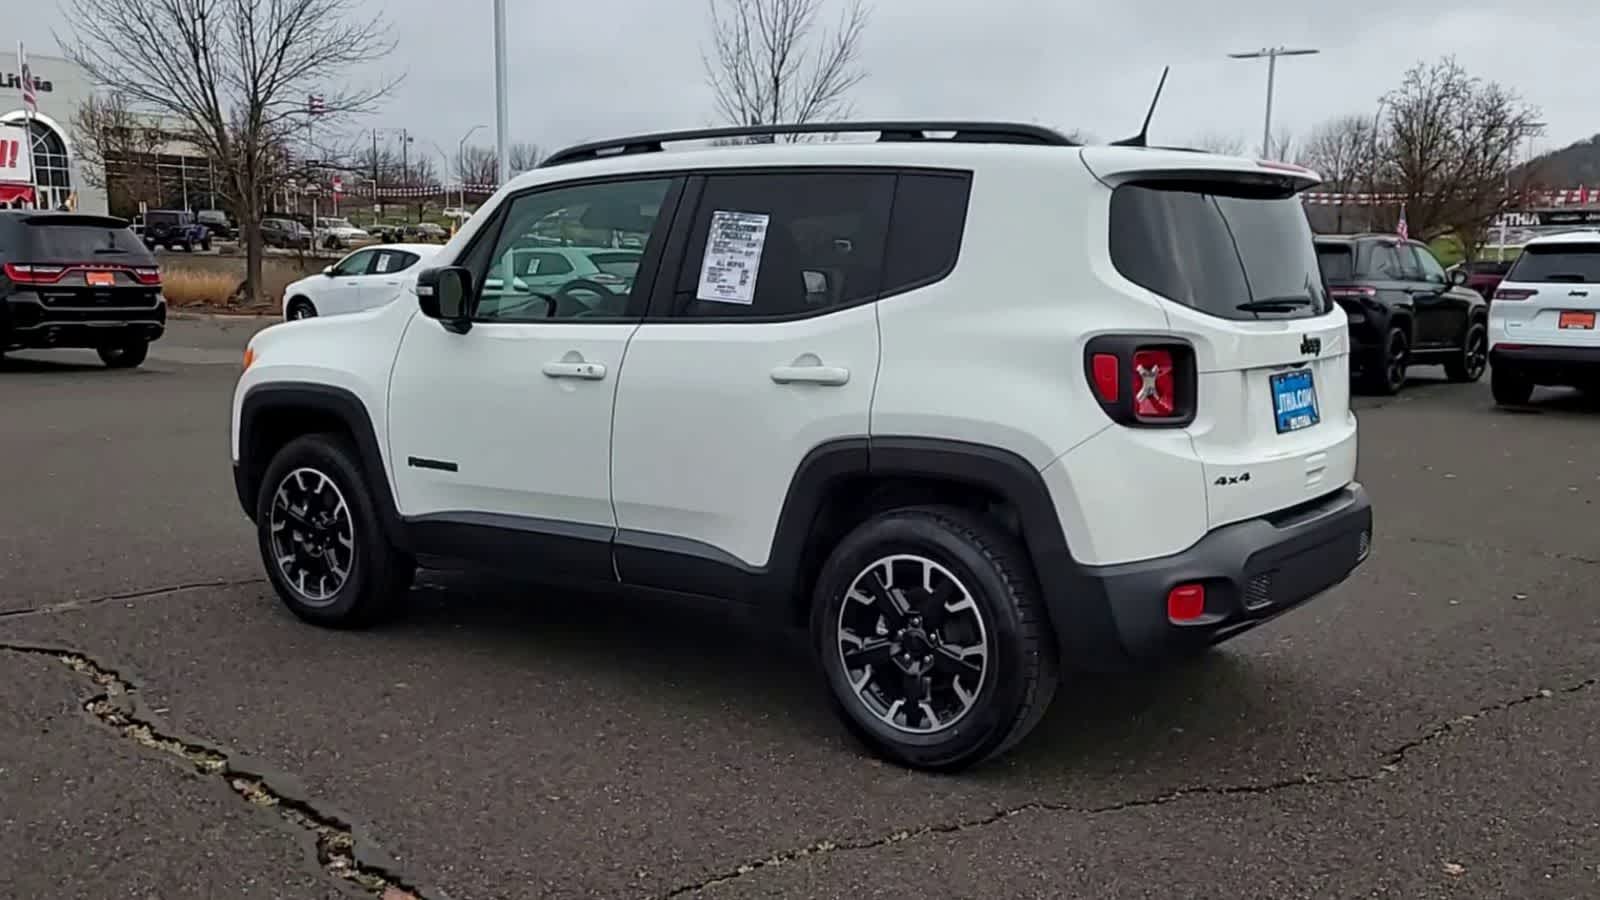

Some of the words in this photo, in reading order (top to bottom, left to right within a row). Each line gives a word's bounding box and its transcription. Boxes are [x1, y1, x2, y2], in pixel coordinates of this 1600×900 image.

[0, 71, 53, 92] Litia
[1300, 333, 1321, 357] Jeep
[1214, 472, 1250, 486] 4x4
